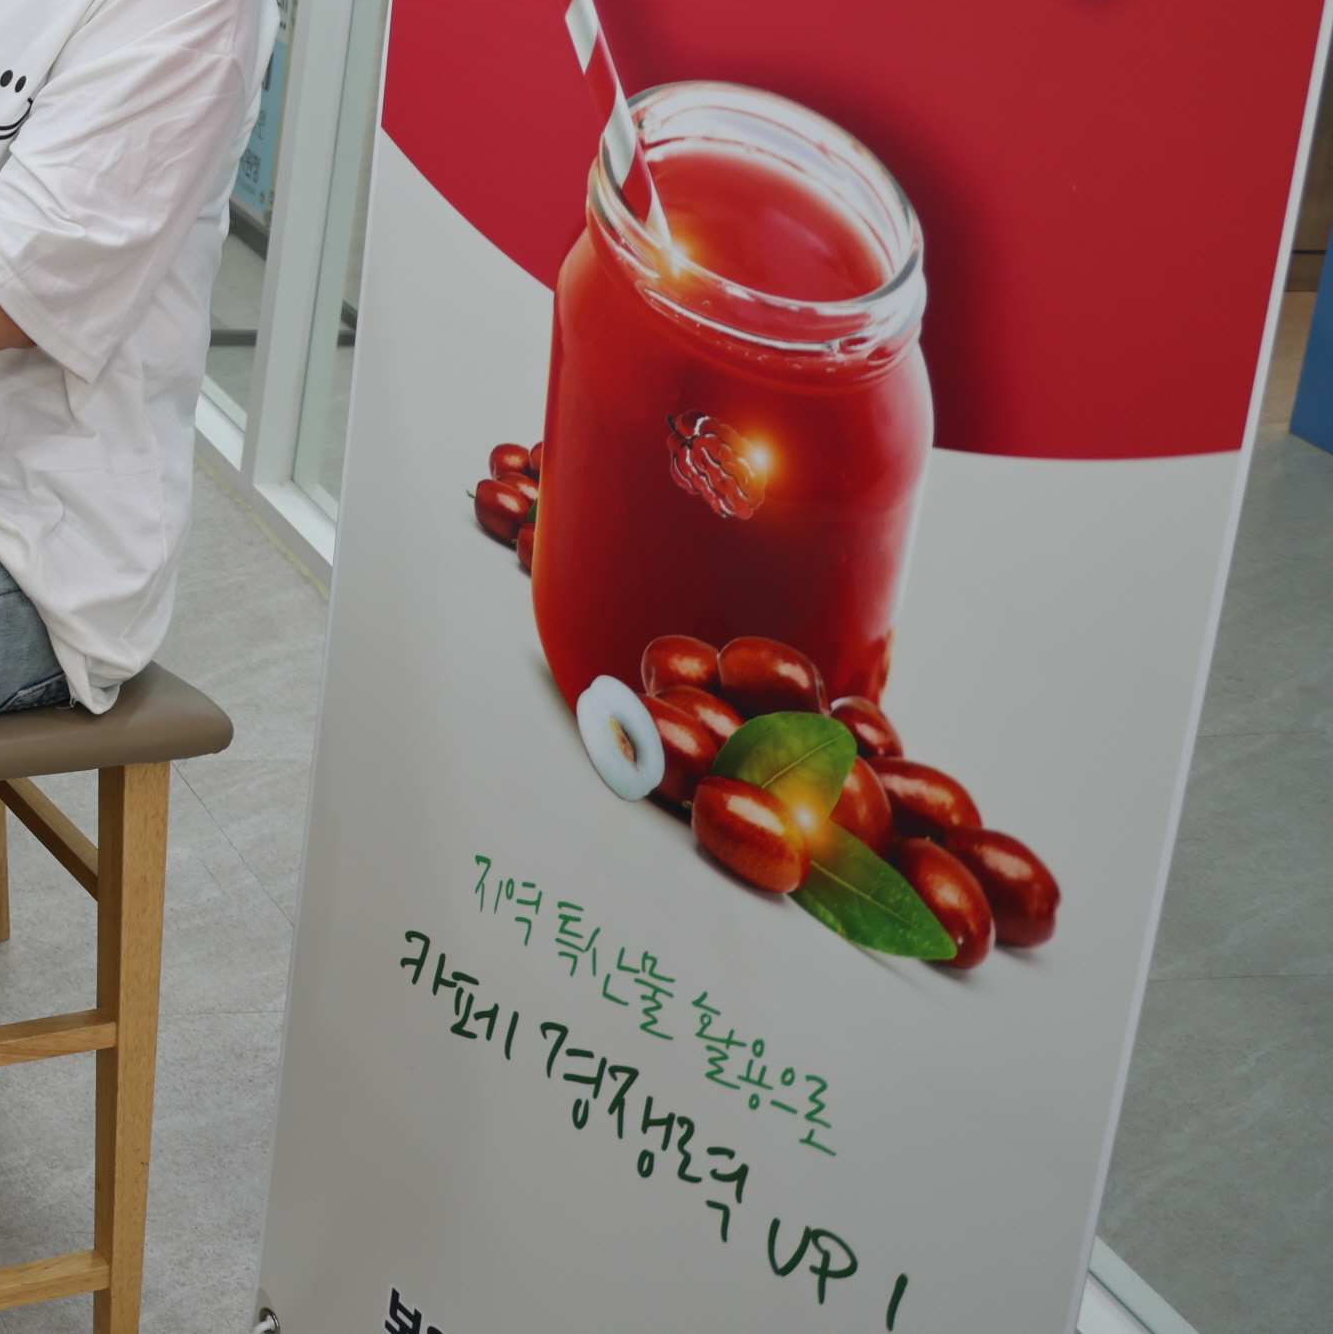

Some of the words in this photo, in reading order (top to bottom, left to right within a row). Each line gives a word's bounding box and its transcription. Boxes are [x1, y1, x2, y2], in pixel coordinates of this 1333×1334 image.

[400, 931, 518, 1059] 카페
[540, 1022, 749, 1243] 경쟁력
[475, 855, 542, 946] 지역
[555, 901, 674, 1040] 특산물
[693, 992, 836, 1156] 활용으로
